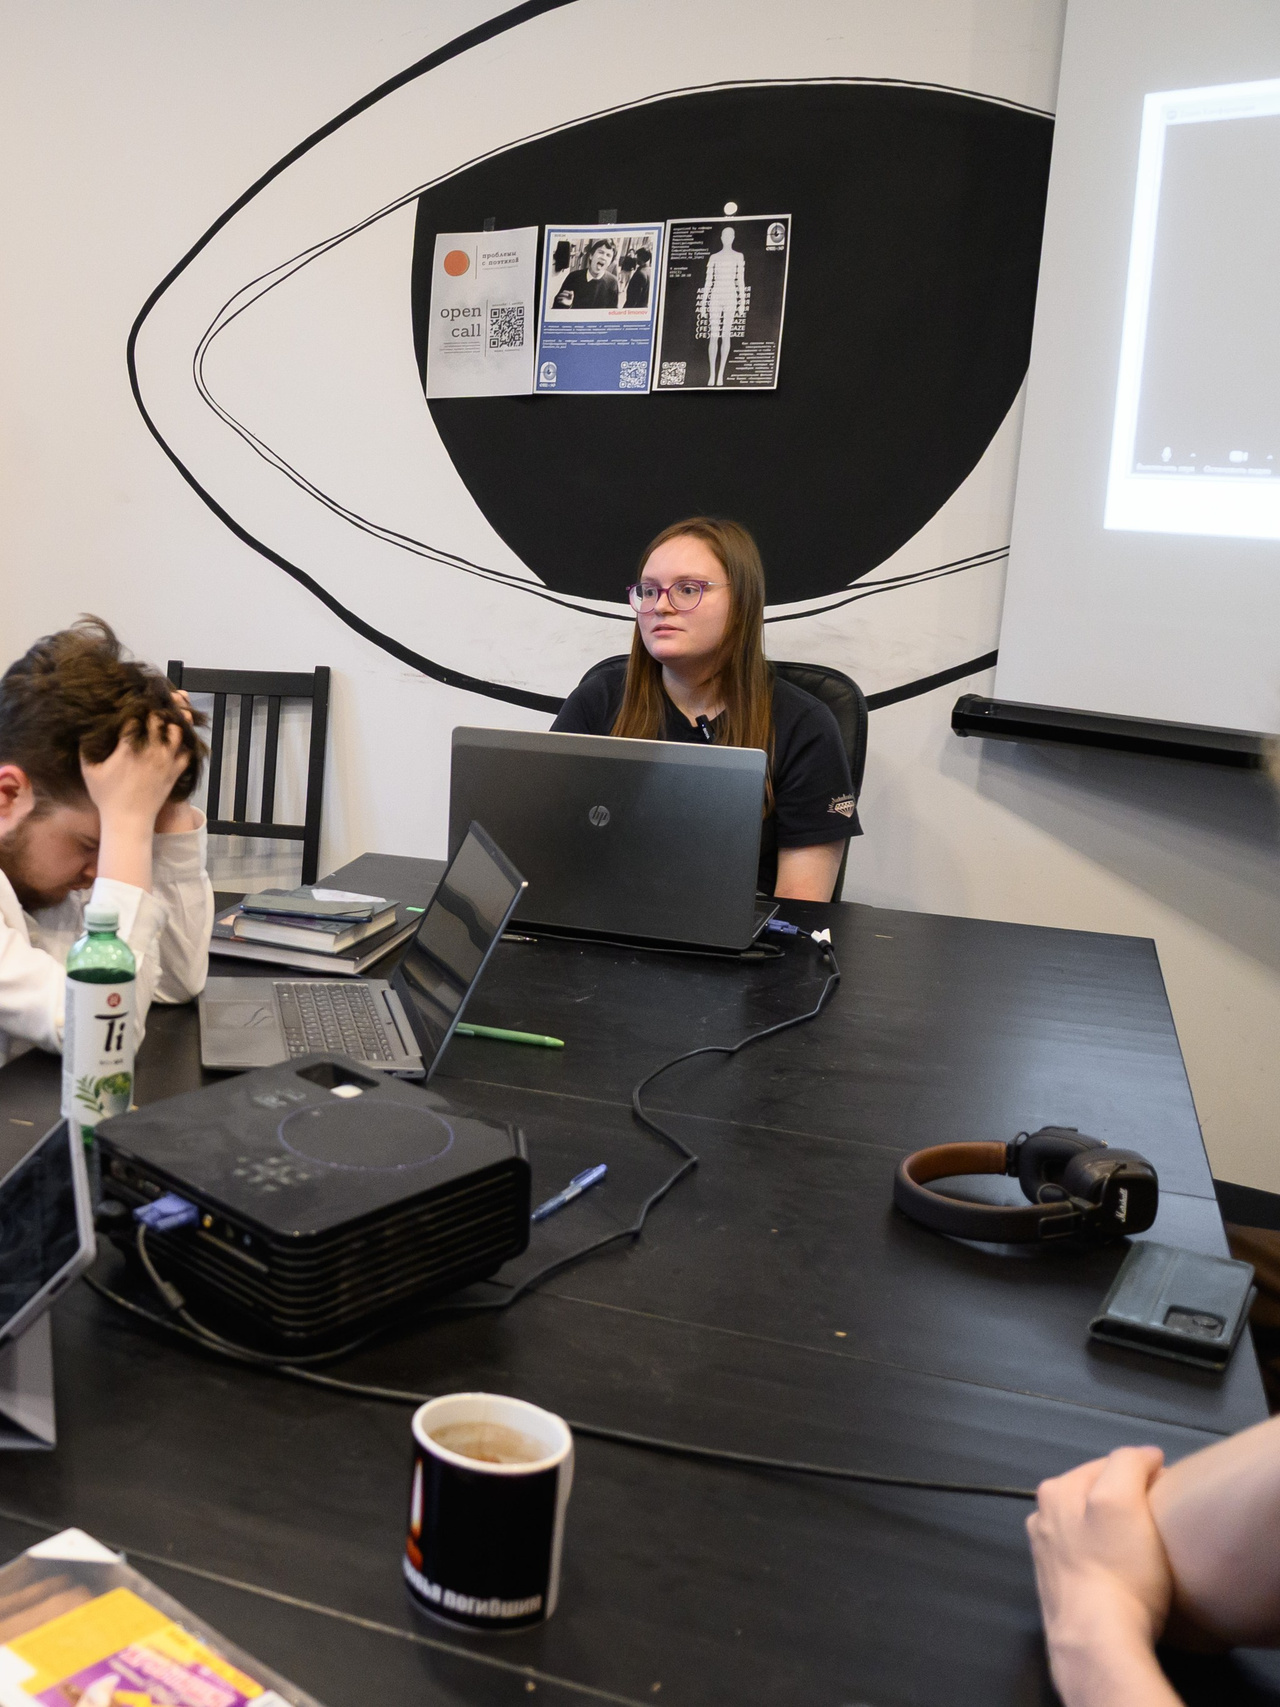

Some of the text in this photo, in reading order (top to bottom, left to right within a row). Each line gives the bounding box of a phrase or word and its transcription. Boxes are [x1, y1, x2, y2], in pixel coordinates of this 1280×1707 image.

[440, 307, 482, 321] open
[451, 324, 482, 338] call
[590, 806, 609, 827] hp
[94, 1011, 129, 1052] Ti
